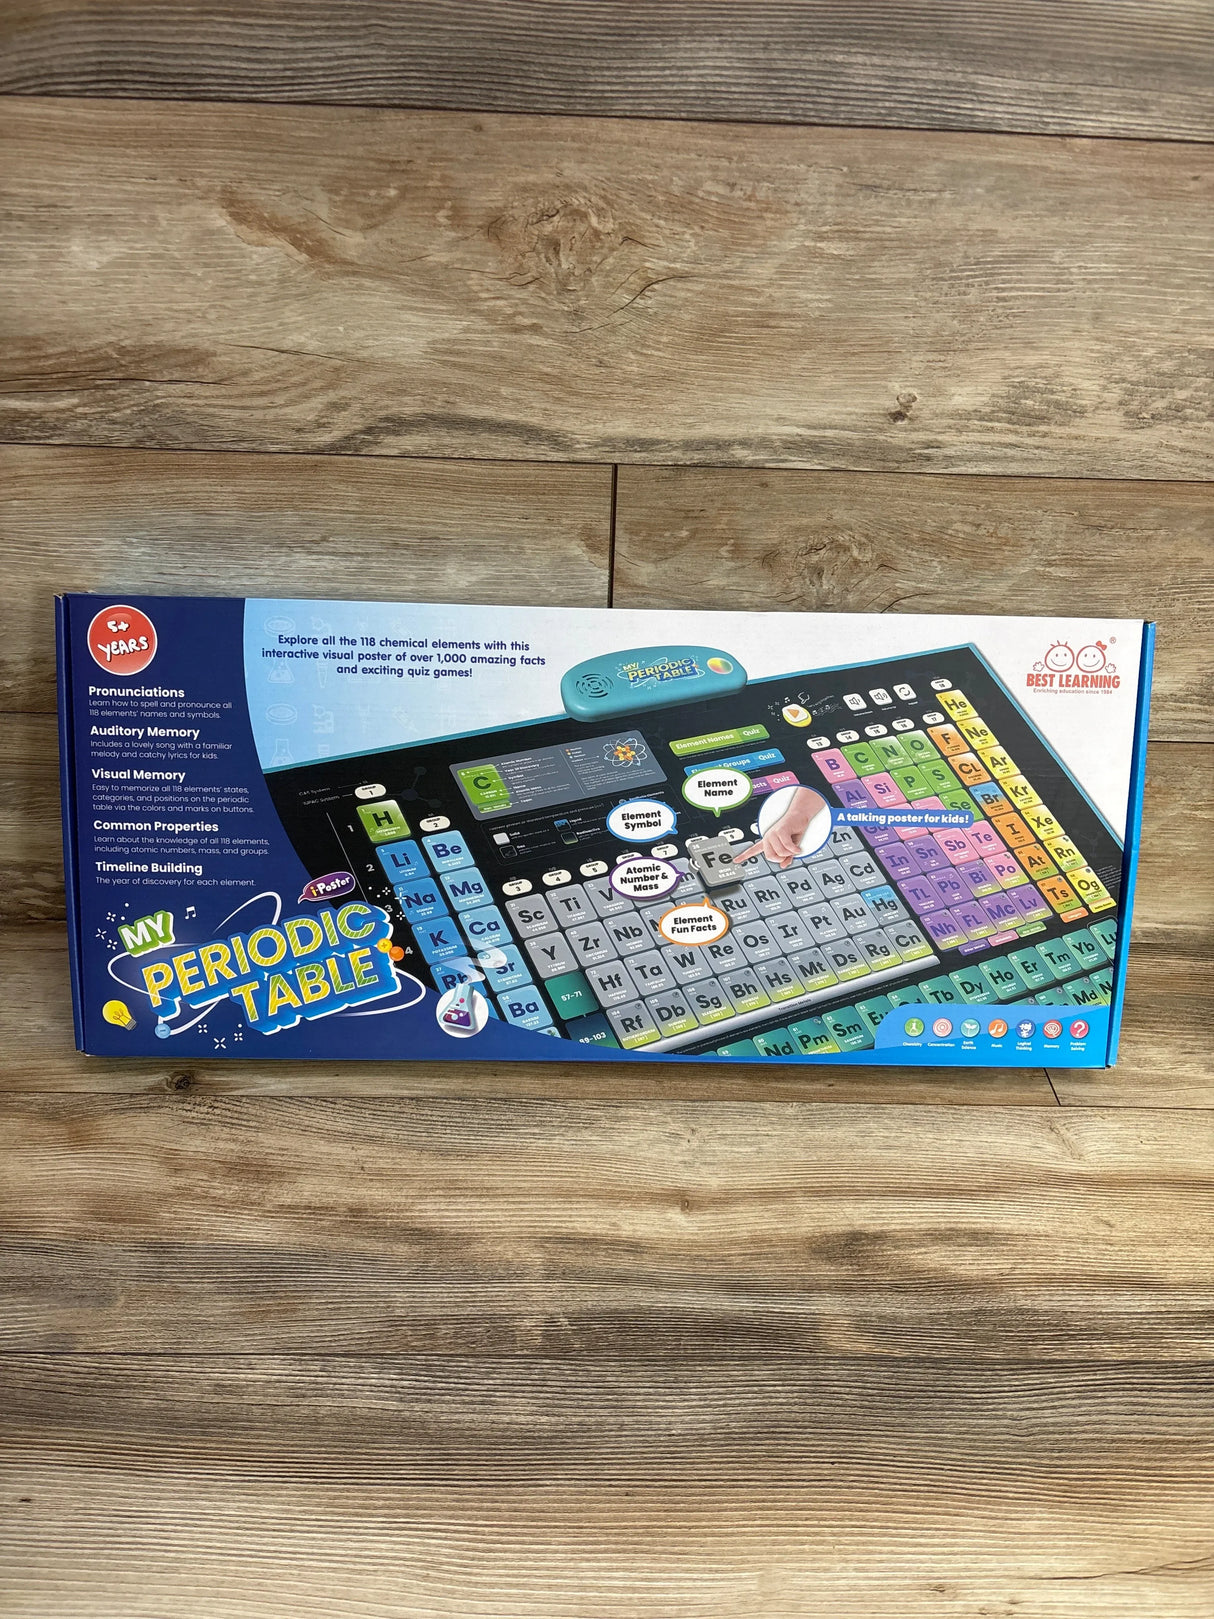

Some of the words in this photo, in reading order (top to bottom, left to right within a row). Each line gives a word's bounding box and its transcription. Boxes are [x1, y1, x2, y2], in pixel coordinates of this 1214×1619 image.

[107, 620, 129, 632] 5+
[97, 636, 149, 661] YEARS
[278, 634, 318, 647] Explore
[321, 635, 335, 645] all
[339, 635, 357, 646] the
[360, 636, 375, 646] 118
[379, 636, 427, 648] chemical
[431, 638, 480, 649] elements
[483, 640, 506, 650] with
[510, 640, 529, 651] this
[262, 647, 319, 659] interactive
[322, 649, 353, 660] visual
[357, 650, 392, 663] poster
[395, 651, 406, 661] of
[409, 654, 433, 662] over
[436, 652, 466, 664] 1,000
[470, 653, 516, 666] amazing
[519, 654, 545, 665] facts
[336, 664, 357, 674] and
[361, 664, 403, 678] exciting
[407, 665, 430, 678] quiz
[433, 667, 472, 679] games!
[622, 662, 636, 671] MY
[628, 658, 691, 681] PERIODIC
[653, 666, 693, 680] TABLE
[1026, 673, 1055, 687] BEST
[1058, 673, 1120, 688] LEARNING
[88, 685, 184, 697] Pronunciations
[140, 700, 158, 709] spell
[945, 700, 967, 710] He
[89, 708, 99, 716] 118
[186, 710, 220, 720] symbols.
[90, 725, 144, 739] Auditory
[147, 726, 200, 740] Memory
[675, 739, 708, 749] Element
[708, 734, 734, 744] Names
[743, 728, 760, 736] Quiz
[967, 728, 988, 738] Ne
[90, 739, 122, 747] Includes
[131, 740, 154, 749] lovely
[155, 742, 175, 750] song
[90, 750, 120, 758] melody
[121, 750, 137, 758] and
[138, 751, 166, 760] catchy
[167, 751, 188, 760] lyrics
[189, 751, 200, 759] for
[825, 758, 840, 770] B
[91, 768, 130, 779] Visual
[133, 769, 185, 783] Memory
[773, 775, 790, 784] Quiz
[92, 783, 109, 792] Easy
[120, 784, 159, 792] memorize
[698, 779, 738, 788] Element
[92, 794, 134, 802] categories,
[153, 794, 188, 803] positions
[217, 795, 249, 804] periodic
[704, 789, 733, 797] Name
[373, 811, 393, 827] H
[621, 810, 662, 821] Element
[846, 812, 886, 824] talking
[888, 814, 924, 824] poster
[925, 814, 940, 822] for
[941, 814, 968, 823] kids!
[1032, 816, 1052, 828] Xe
[93, 820, 151, 830] Common
[154, 820, 218, 833] Properties
[624, 820, 662, 831] Symbol
[155, 836, 198, 846] knowledge
[231, 837, 269, 845] elements,
[944, 839, 966, 850] Sb
[94, 845, 129, 854] including
[160, 846, 196, 854] numbers,
[239, 848, 268, 856] groups.
[432, 843, 462, 858] Be
[390, 852, 411, 867] Li
[702, 850, 733, 868] Fe
[95, 860, 148, 872] Timeline
[151, 861, 202, 875] Building
[626, 864, 661, 874] Atomic
[850, 862, 875, 876] Cd
[96, 876, 110, 884] The
[111, 878, 130, 886] year
[142, 877, 181, 886] discovery
[219, 878, 256, 886] element.
[620, 874, 659, 884] Number
[661, 872, 668, 880] &
[1078, 878, 1100, 891] Og
[450, 881, 484, 898] Mg
[633, 883, 659, 892] Mass
[404, 892, 435, 908] Na
[518, 910, 545, 923] Sc
[674, 915, 713, 925] Element
[811, 915, 832, 930] Pt
[120, 914, 166, 950] MY
[468, 921, 501, 934] Ca
[671, 925, 689, 934] Fun
[690, 923, 717, 932] Facts
[578, 936, 600, 951] Zr
[743, 933, 769, 948] Os
[141, 904, 375, 1008] PERIODIC
[635, 964, 663, 980] Ta
[989, 971, 1013, 984] Ho
[231, 948, 378, 1023] TABLE
[561, 990, 582, 1002] 57-71
[508, 1001, 540, 1018] Ba
